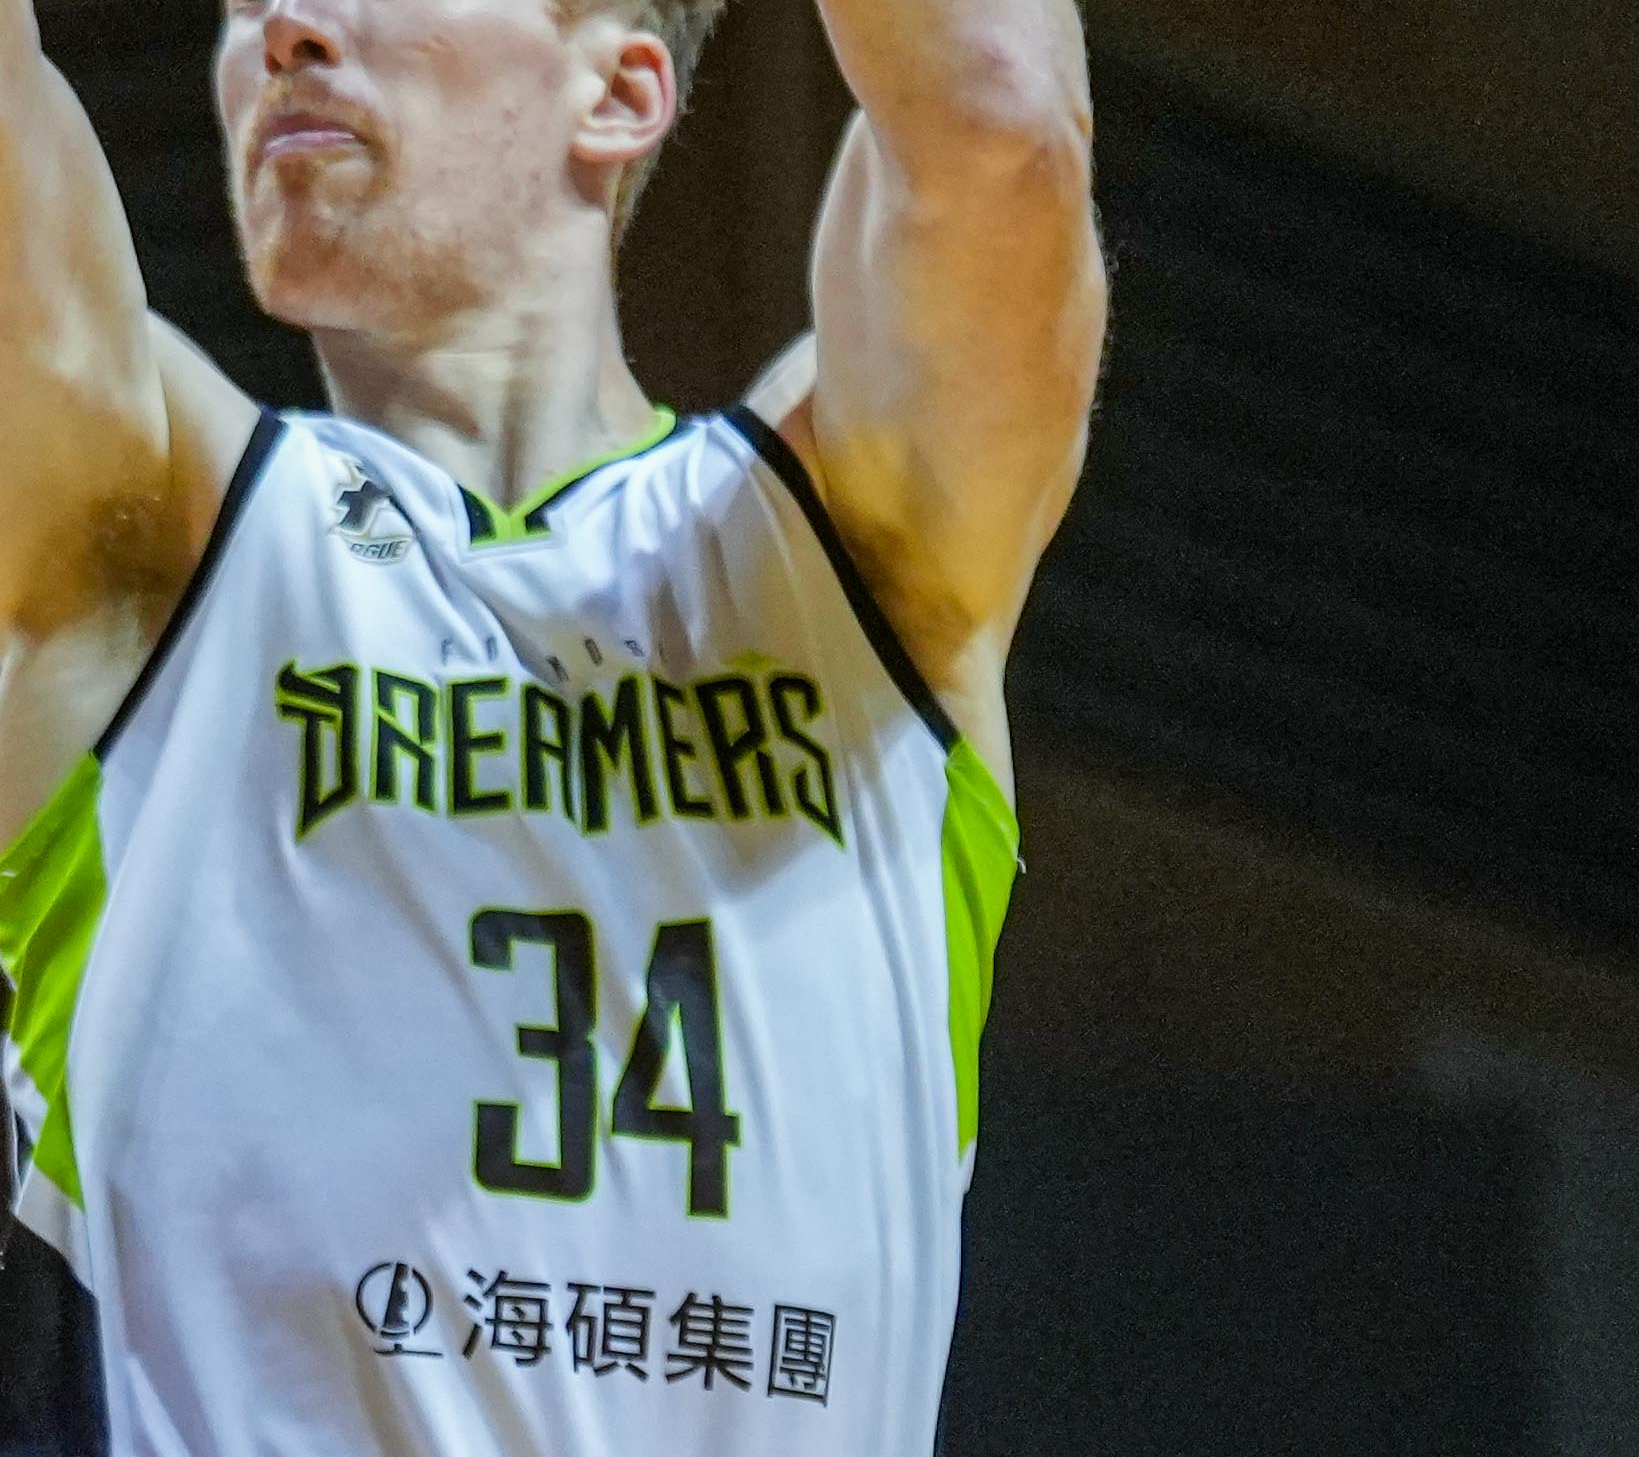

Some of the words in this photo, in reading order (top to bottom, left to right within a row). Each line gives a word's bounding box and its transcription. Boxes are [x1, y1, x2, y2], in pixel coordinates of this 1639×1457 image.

[274, 655, 847, 850] DREAMERS
[469, 905, 741, 1220] 34
[459, 1266, 838, 1409] 海碩集團
